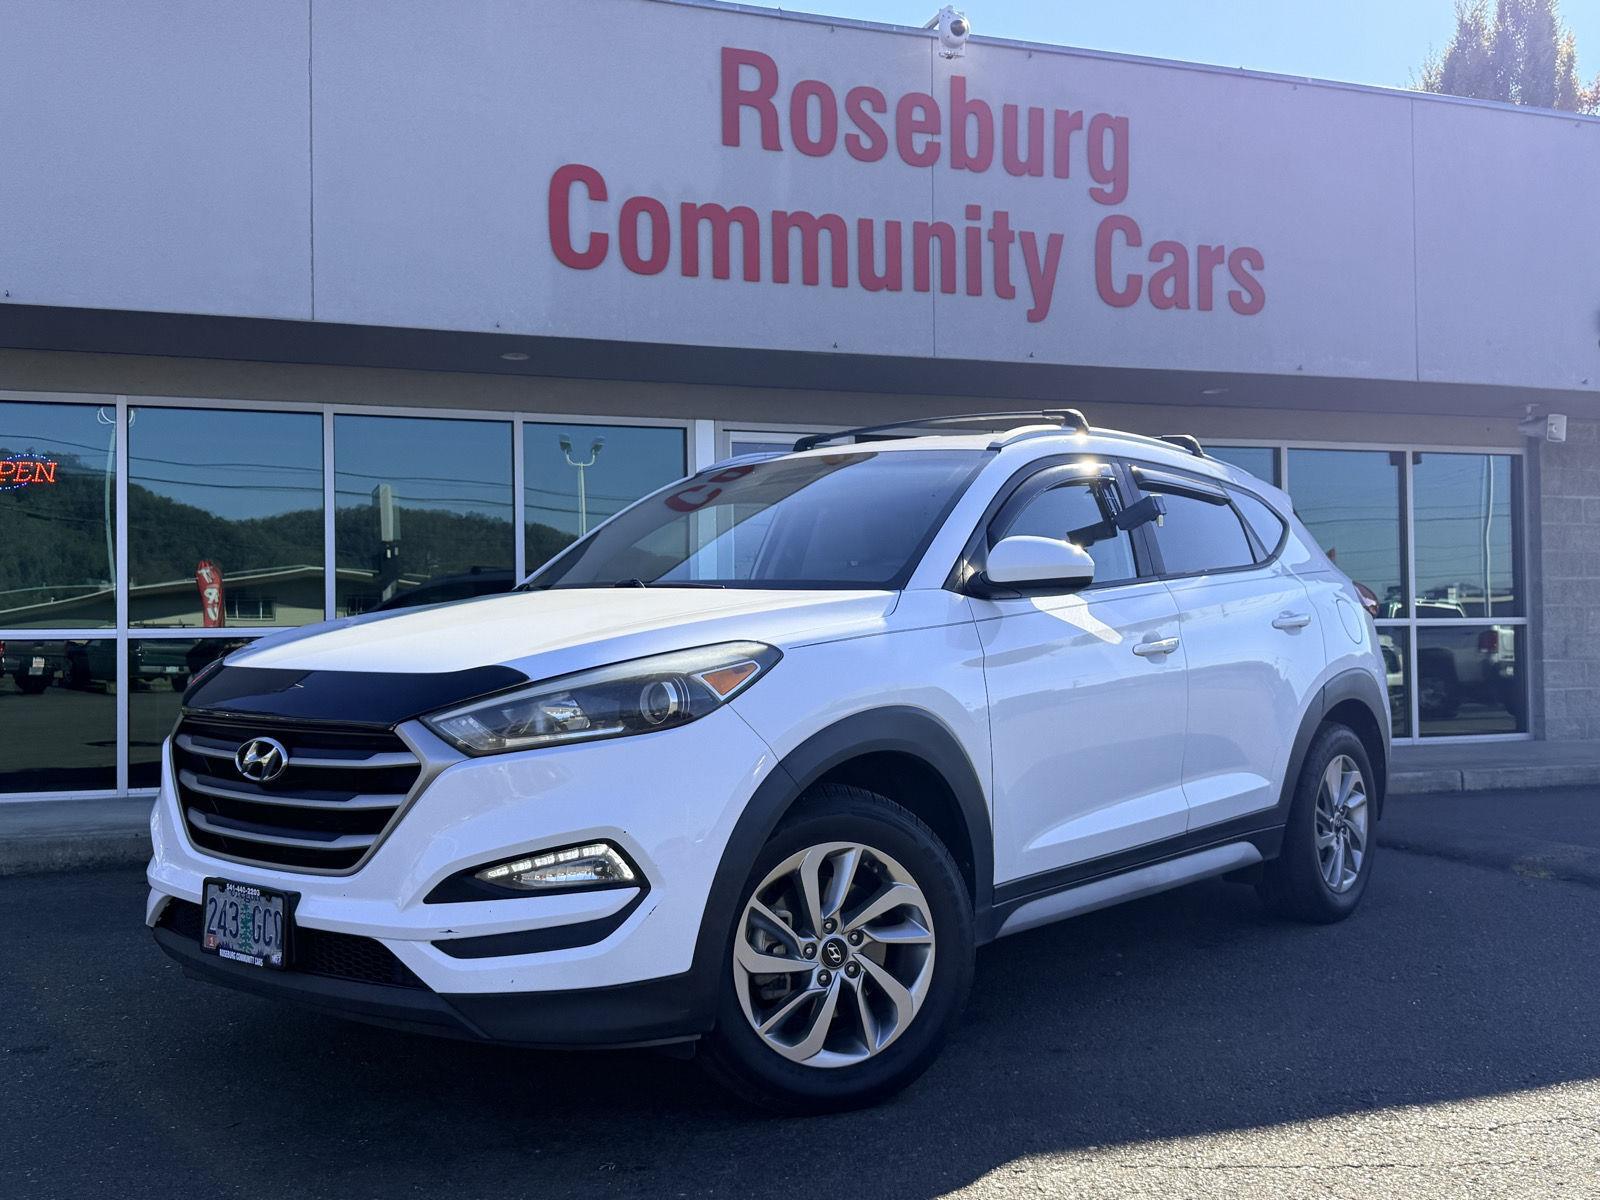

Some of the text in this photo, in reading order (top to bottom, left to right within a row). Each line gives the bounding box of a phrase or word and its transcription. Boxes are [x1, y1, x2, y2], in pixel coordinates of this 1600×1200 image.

[720, 46, 1129, 205] Roseburg
[549, 163, 1266, 323] Community Cars
[0, 460, 58, 484] PEN
[207, 897, 240, 939] 243
